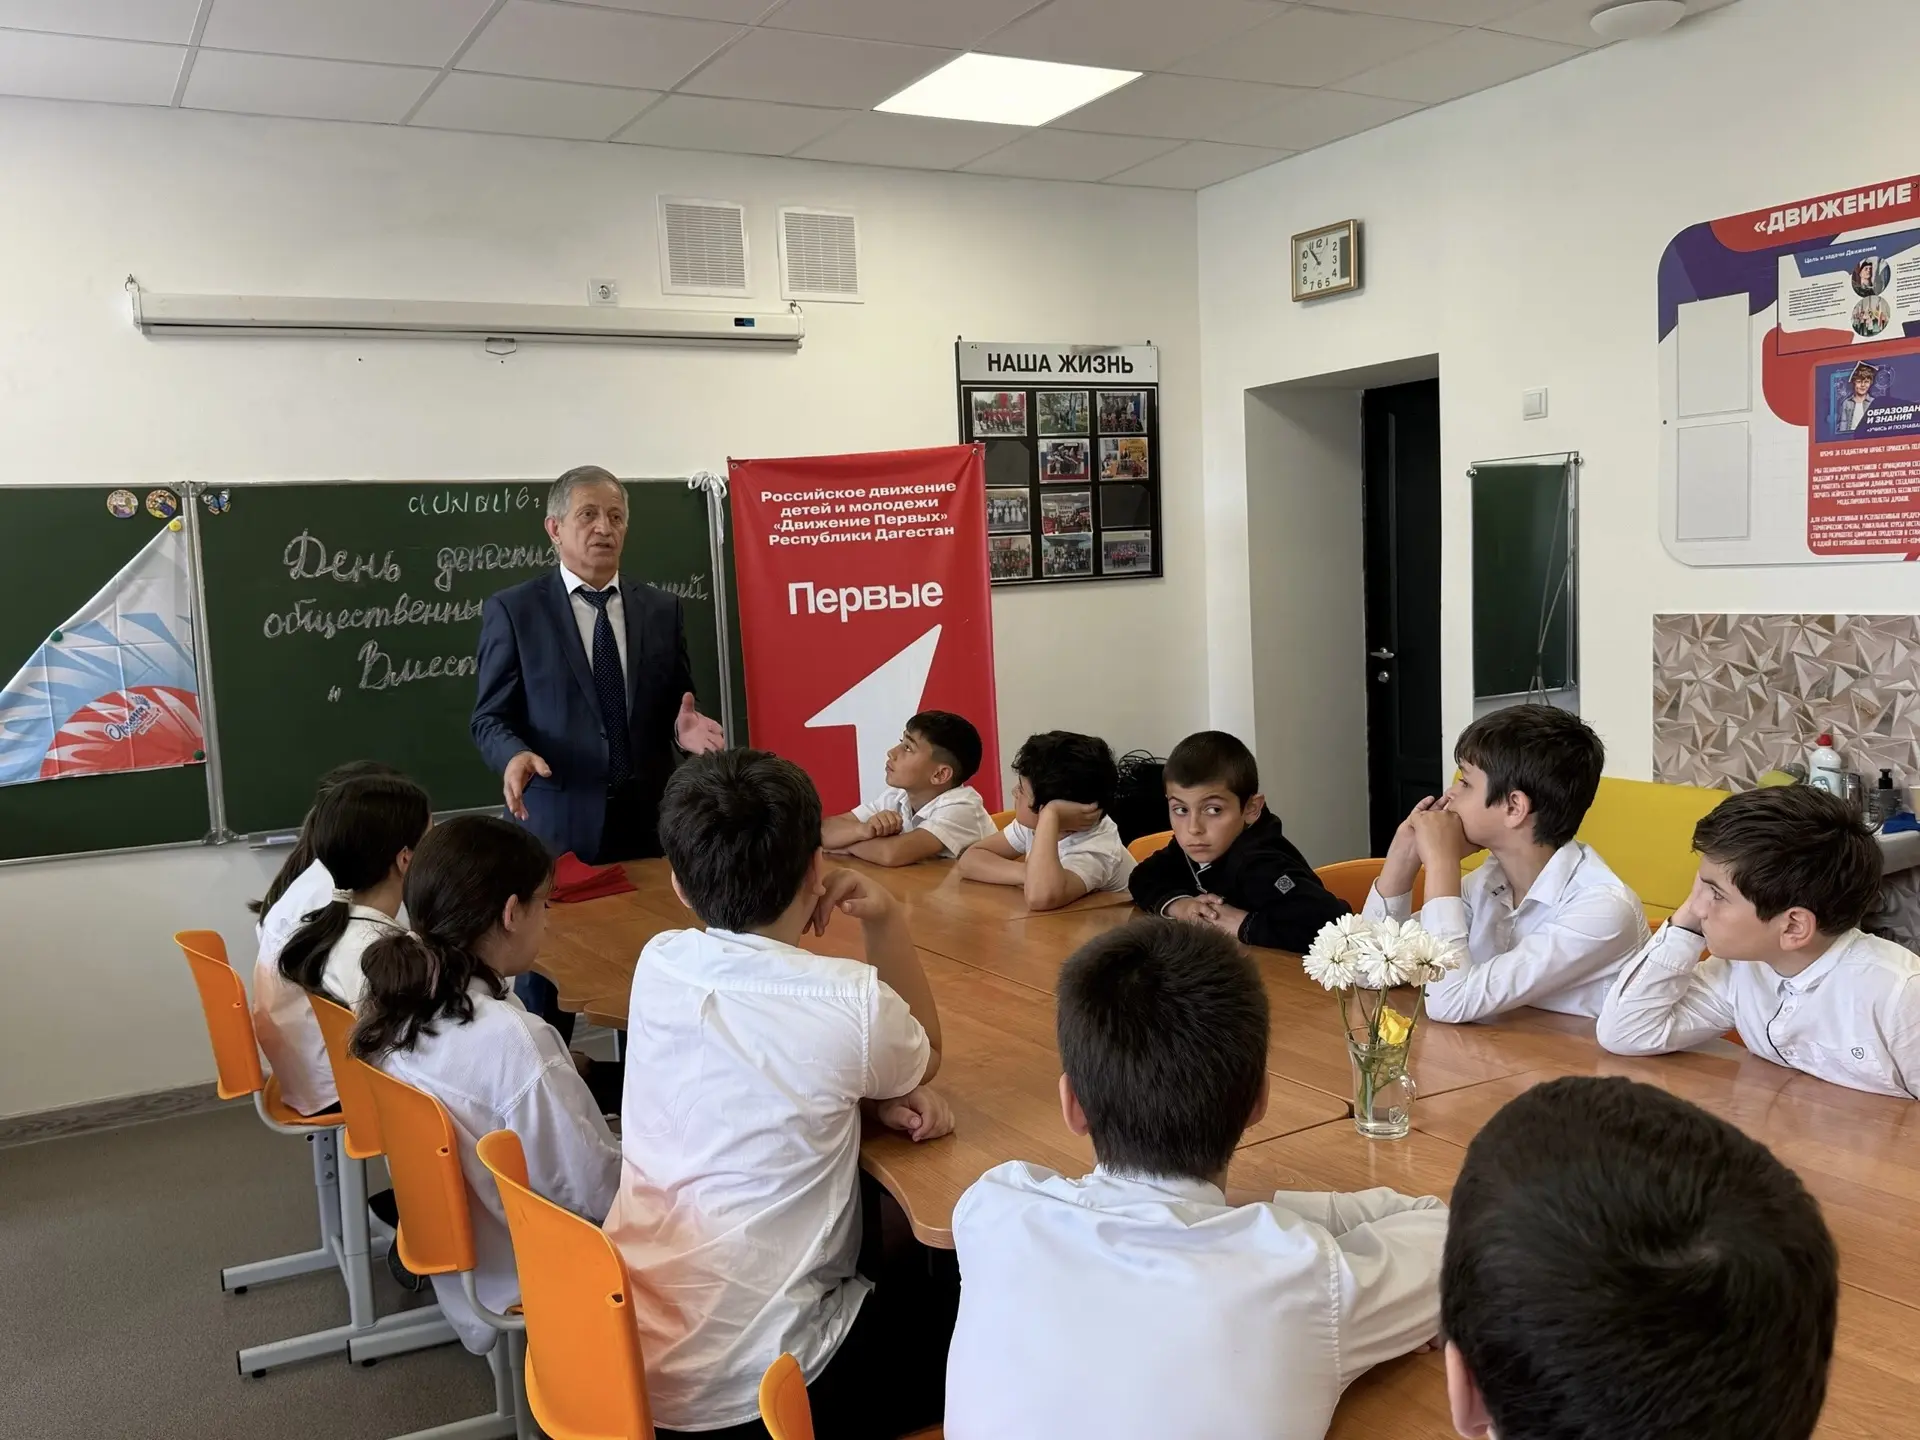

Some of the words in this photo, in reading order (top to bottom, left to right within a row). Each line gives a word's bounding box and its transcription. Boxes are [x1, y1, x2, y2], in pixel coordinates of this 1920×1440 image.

[1754, 183, 1912, 234] «ДВИЖЕНИЕ
[1332, 241, 1338, 251] 2
[1302, 263, 1308, 272] 9
[1332, 255, 1337, 264] 3
[1302, 276, 1308, 285] 8
[1332, 268, 1337, 278] 4
[1310, 280, 1315, 290] 7
[1317, 279, 1323, 288] 6
[1325, 277, 1330, 287] 5
[987, 353, 1052, 373] НАША
[1058, 354, 1134, 374] ЖИЗНЬ
[1866, 416, 1874, 424] И
[1875, 413, 1913, 424] ЗНАНИЯ
[761, 488, 865, 503] Российское
[869, 481, 956, 499] движение
[780, 502, 831, 518] детей
[835, 504, 845, 513] и
[849, 497, 939, 513] молодежи
[774, 516, 870, 533] «Движение
[874, 511, 948, 528] Первых»
[769, 530, 871, 546] Республики
[875, 525, 954, 541] Дагестан
[283, 528, 401, 583] День
[788, 581, 943, 623] Первые
[263, 592, 484, 639] общественны
